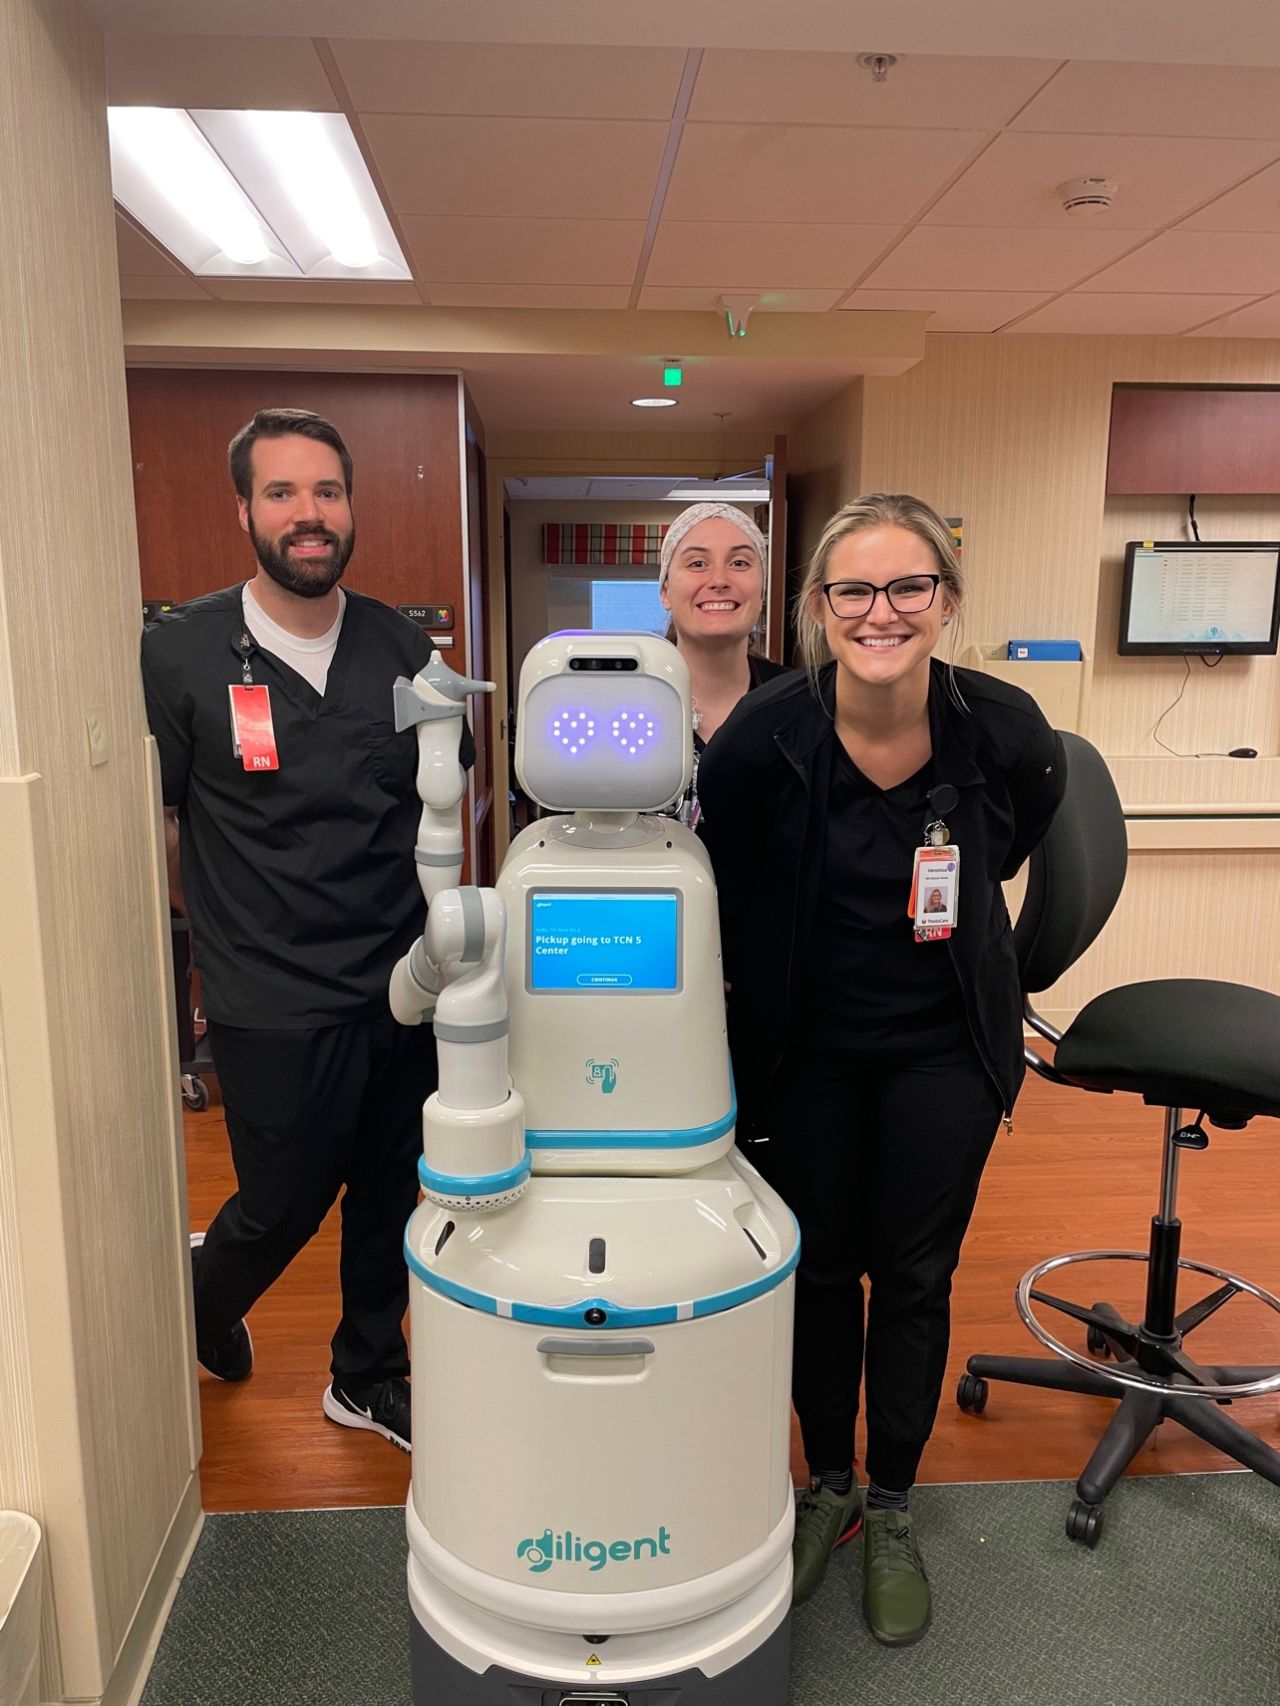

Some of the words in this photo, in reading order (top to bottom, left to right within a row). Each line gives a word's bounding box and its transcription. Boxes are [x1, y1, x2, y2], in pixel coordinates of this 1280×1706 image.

[408, 609, 426, 617] S562
[253, 756, 271, 767] RN
[925, 927, 943, 938] RN
[535, 935, 569, 946] Pickup
[571, 935, 598, 947] going
[600, 936, 611, 944] to
[613, 935, 633, 944] TCN
[635, 935, 642, 944] 5
[535, 946, 569, 955] Center
[517, 1526, 671, 1573] diligent
